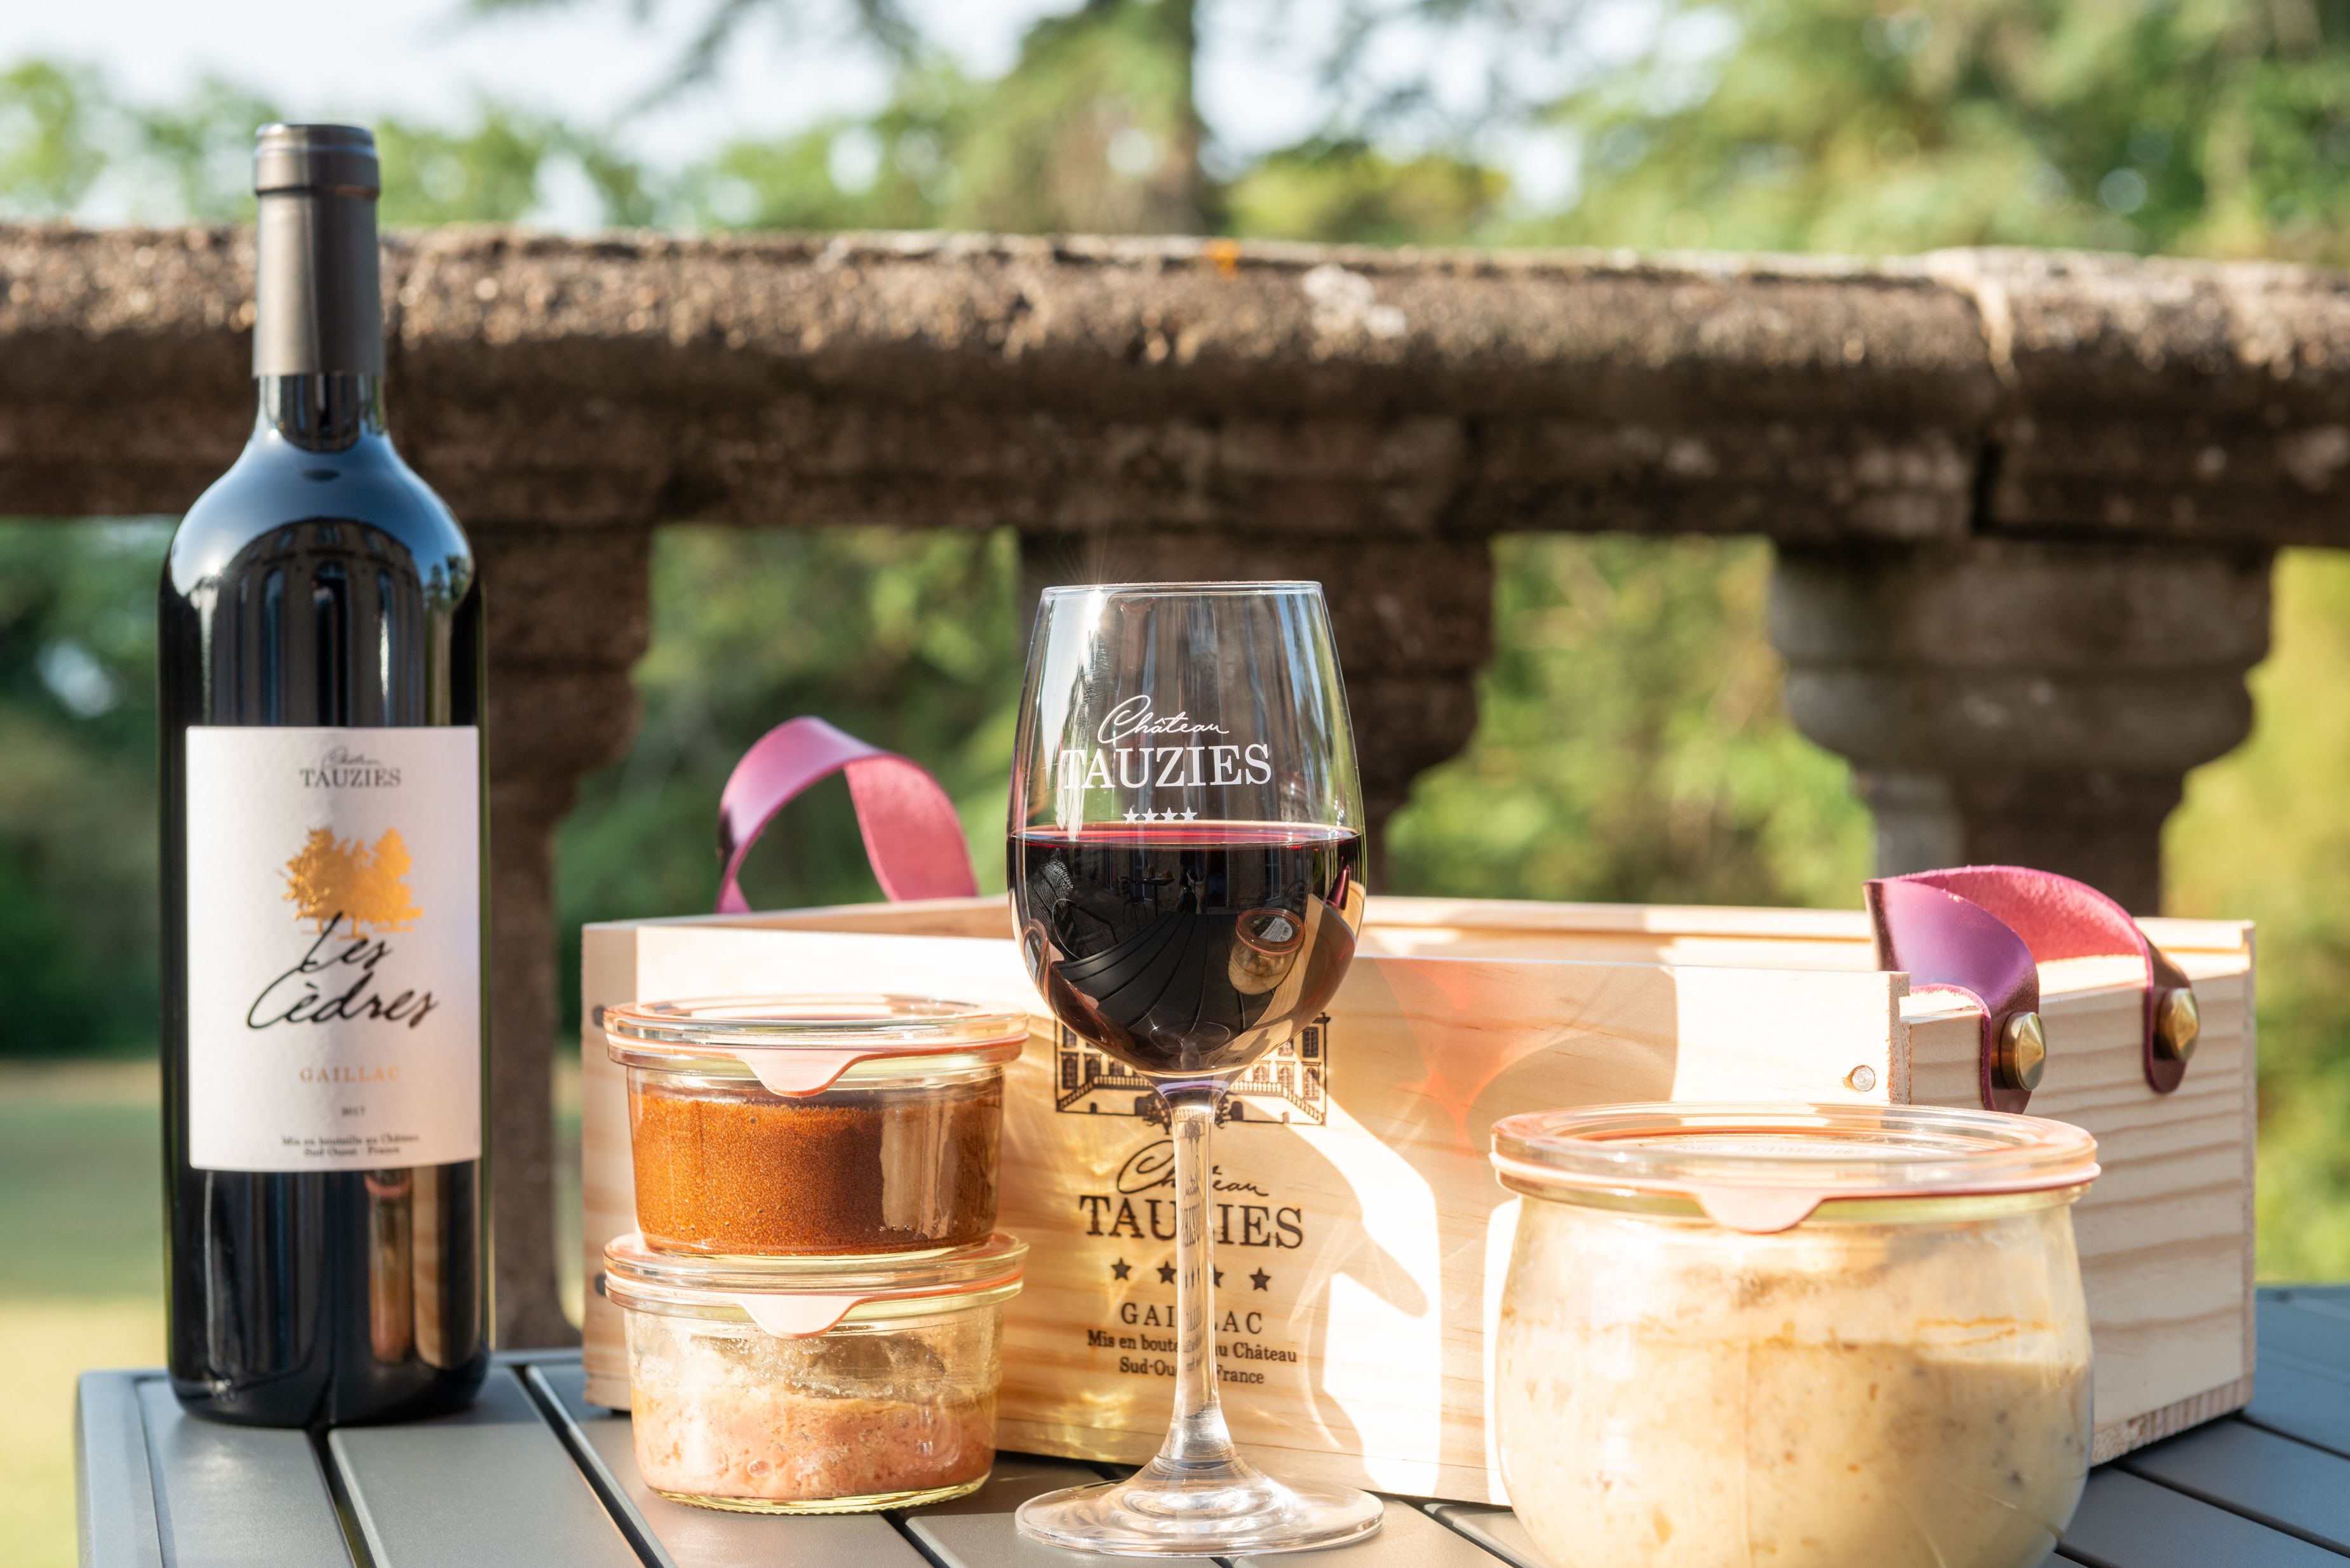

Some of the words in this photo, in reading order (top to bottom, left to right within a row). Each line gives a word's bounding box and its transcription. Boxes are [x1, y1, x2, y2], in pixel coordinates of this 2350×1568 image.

[1098, 694, 1230, 744] Château
[299, 767, 402, 788] TAUZIES
[1061, 744, 1272, 789] TAUZIES
[299, 910, 392, 973] Les
[246, 963, 439, 1029] Cèdres
[299, 1064, 401, 1083] GAILLAC
[1117, 1139, 1269, 1196] Cheau
[1080, 1195, 1304, 1249] TAUIES
[1120, 1303, 1262, 1335] GAIAC
[1087, 1329, 1115, 1348] Mis
[1119, 1336, 1137, 1350] en
[1141, 1334, 1178, 1353] boute
[1233, 1341, 1298, 1364] Château
[1119, 1357, 1176, 1377] Sud-Ou
